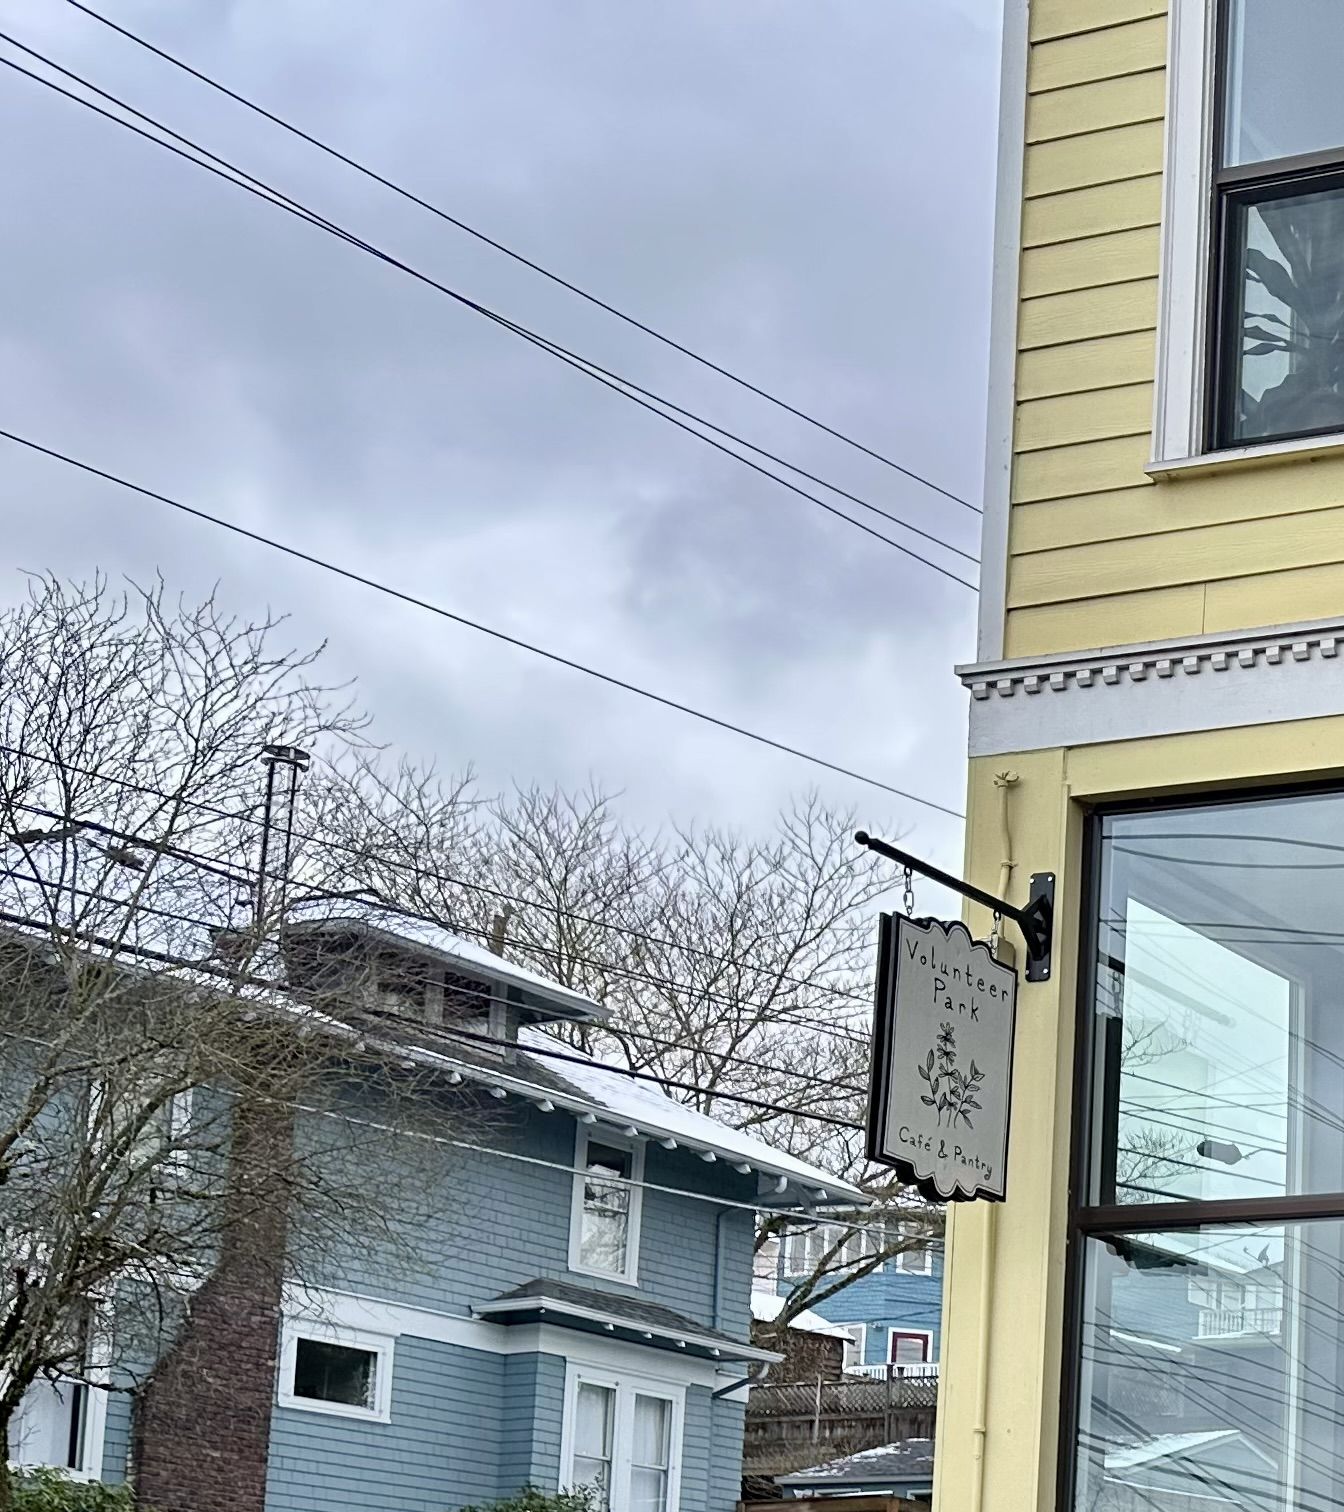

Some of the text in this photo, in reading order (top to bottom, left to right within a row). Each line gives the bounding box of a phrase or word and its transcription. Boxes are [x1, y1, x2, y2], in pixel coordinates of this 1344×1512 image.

[906, 938, 1009, 1002] Volunteer
[933, 977, 979, 1022] Park
[899, 1126, 993, 1181] Café & Pantry
